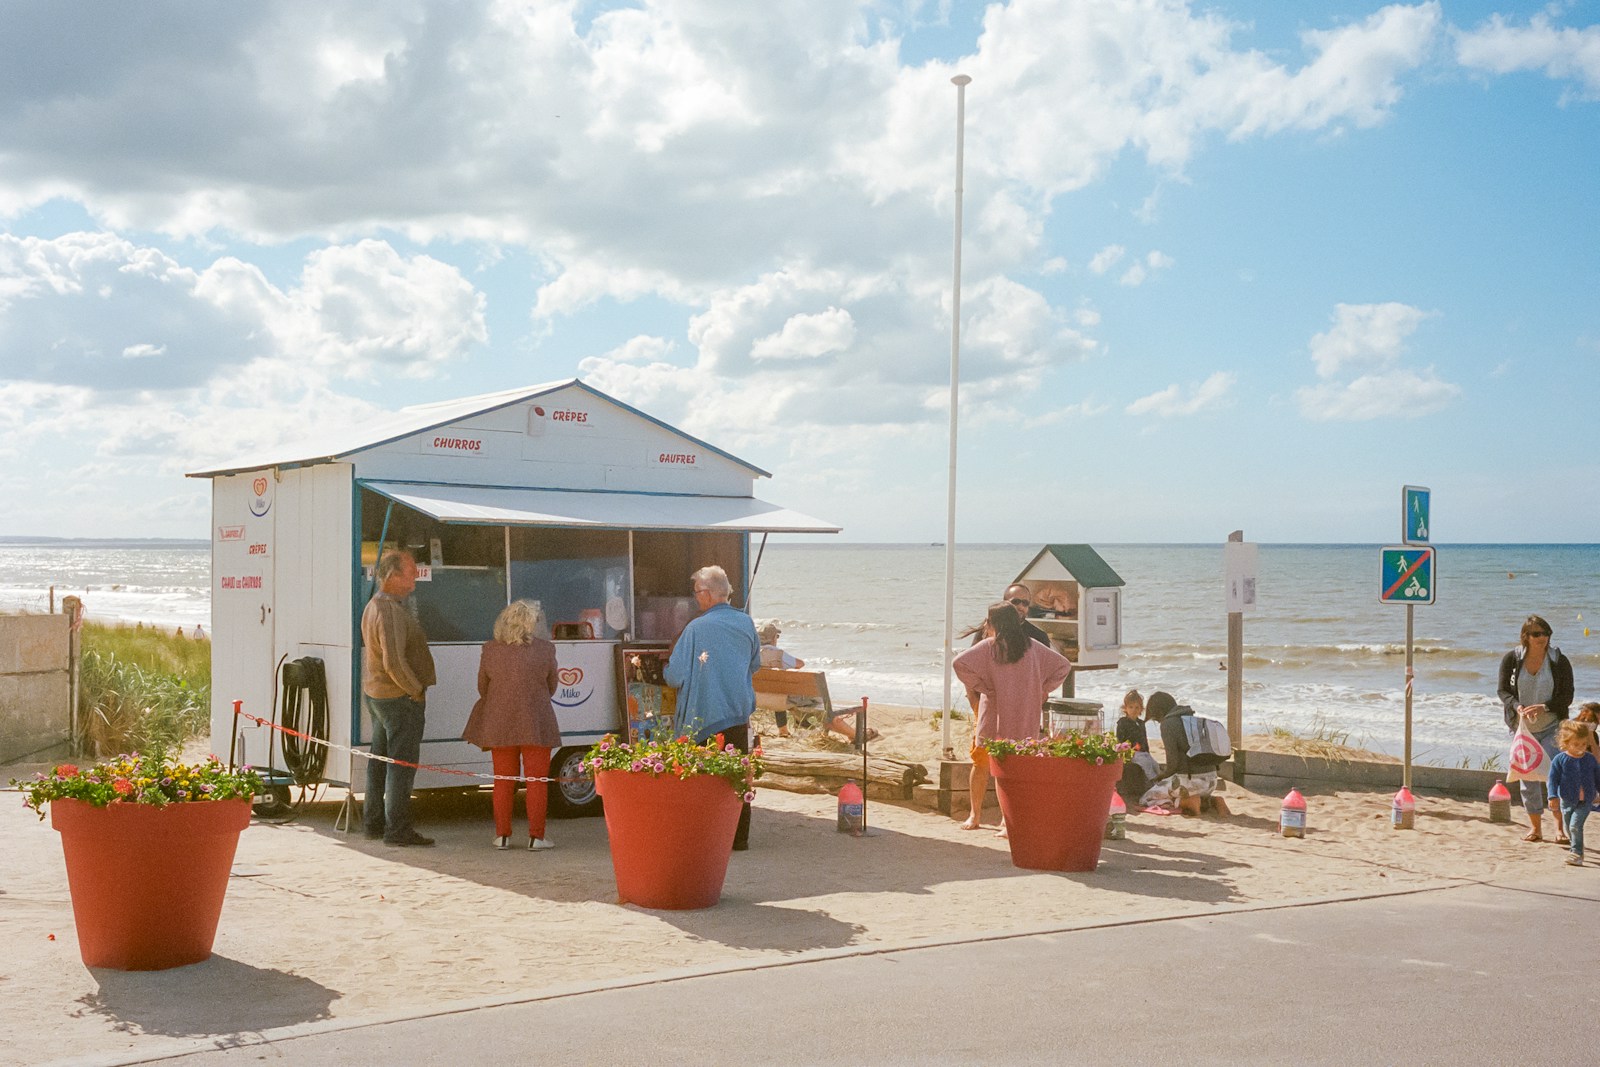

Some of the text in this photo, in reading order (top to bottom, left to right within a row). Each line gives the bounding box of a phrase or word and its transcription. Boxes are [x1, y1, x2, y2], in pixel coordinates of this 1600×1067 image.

[553, 408, 588, 423] CRÊPES
[433, 437, 482, 451] CHURROS
[659, 453, 696, 465] GAUFRES
[560, 687, 581, 699] Miko
